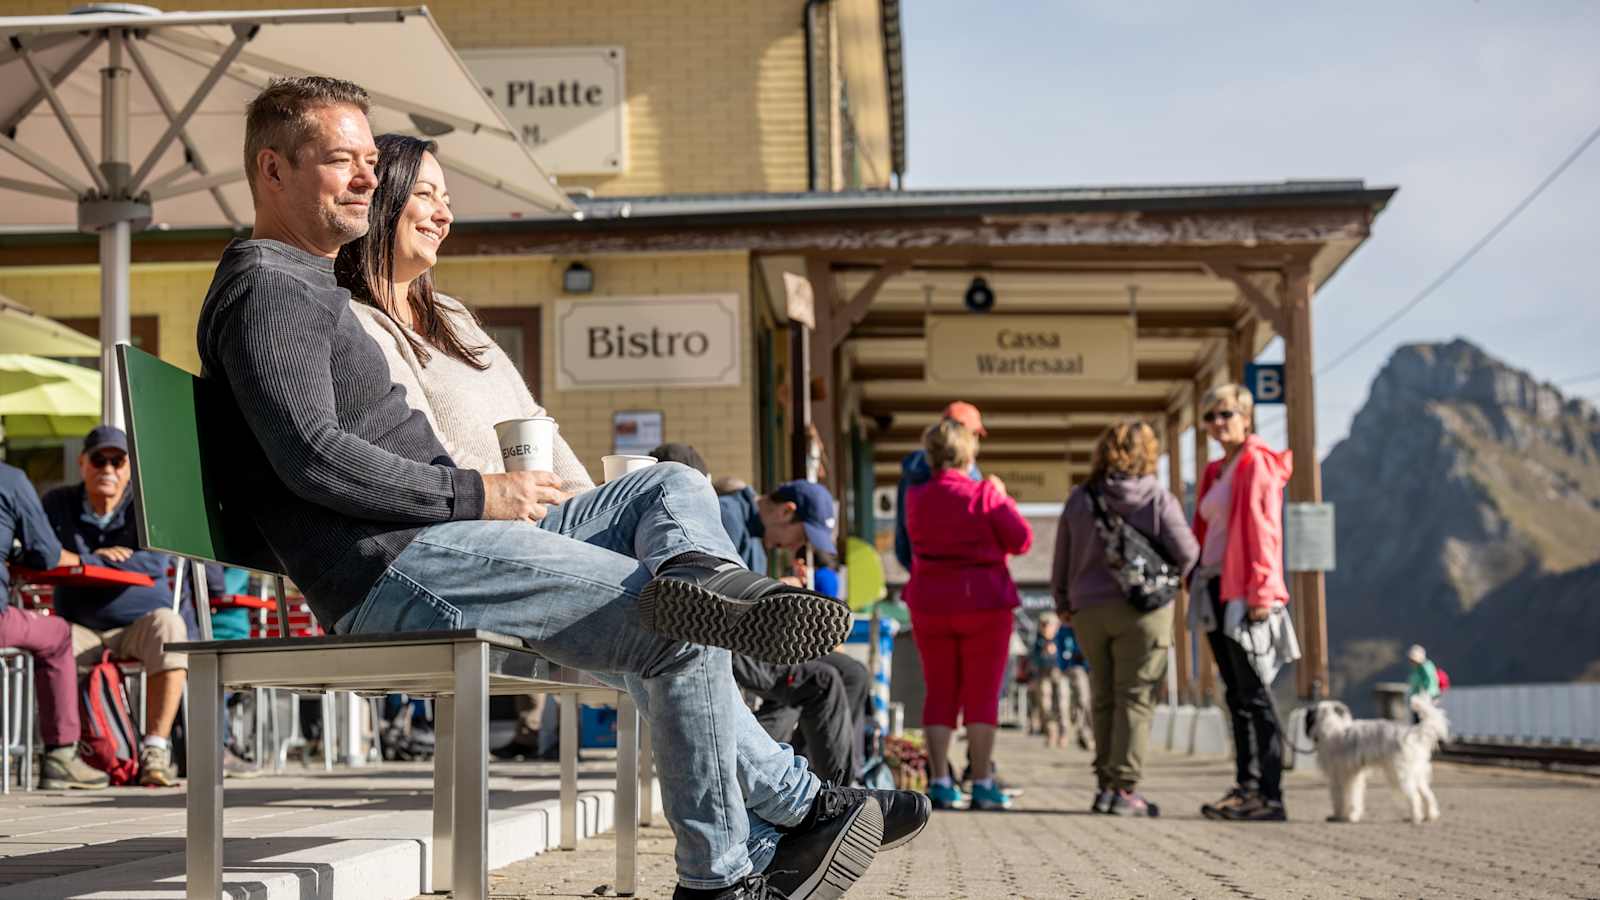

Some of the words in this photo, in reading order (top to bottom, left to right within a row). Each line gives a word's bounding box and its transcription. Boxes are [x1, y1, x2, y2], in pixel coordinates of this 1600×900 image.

[506, 80, 603, 108] Platte
[587, 325, 709, 359] Bistro
[997, 329, 1061, 350] Cassa
[976, 354, 1084, 376] Wartesaal
[1255, 368, 1283, 400] B
[502, 444, 532, 459] EIGER
